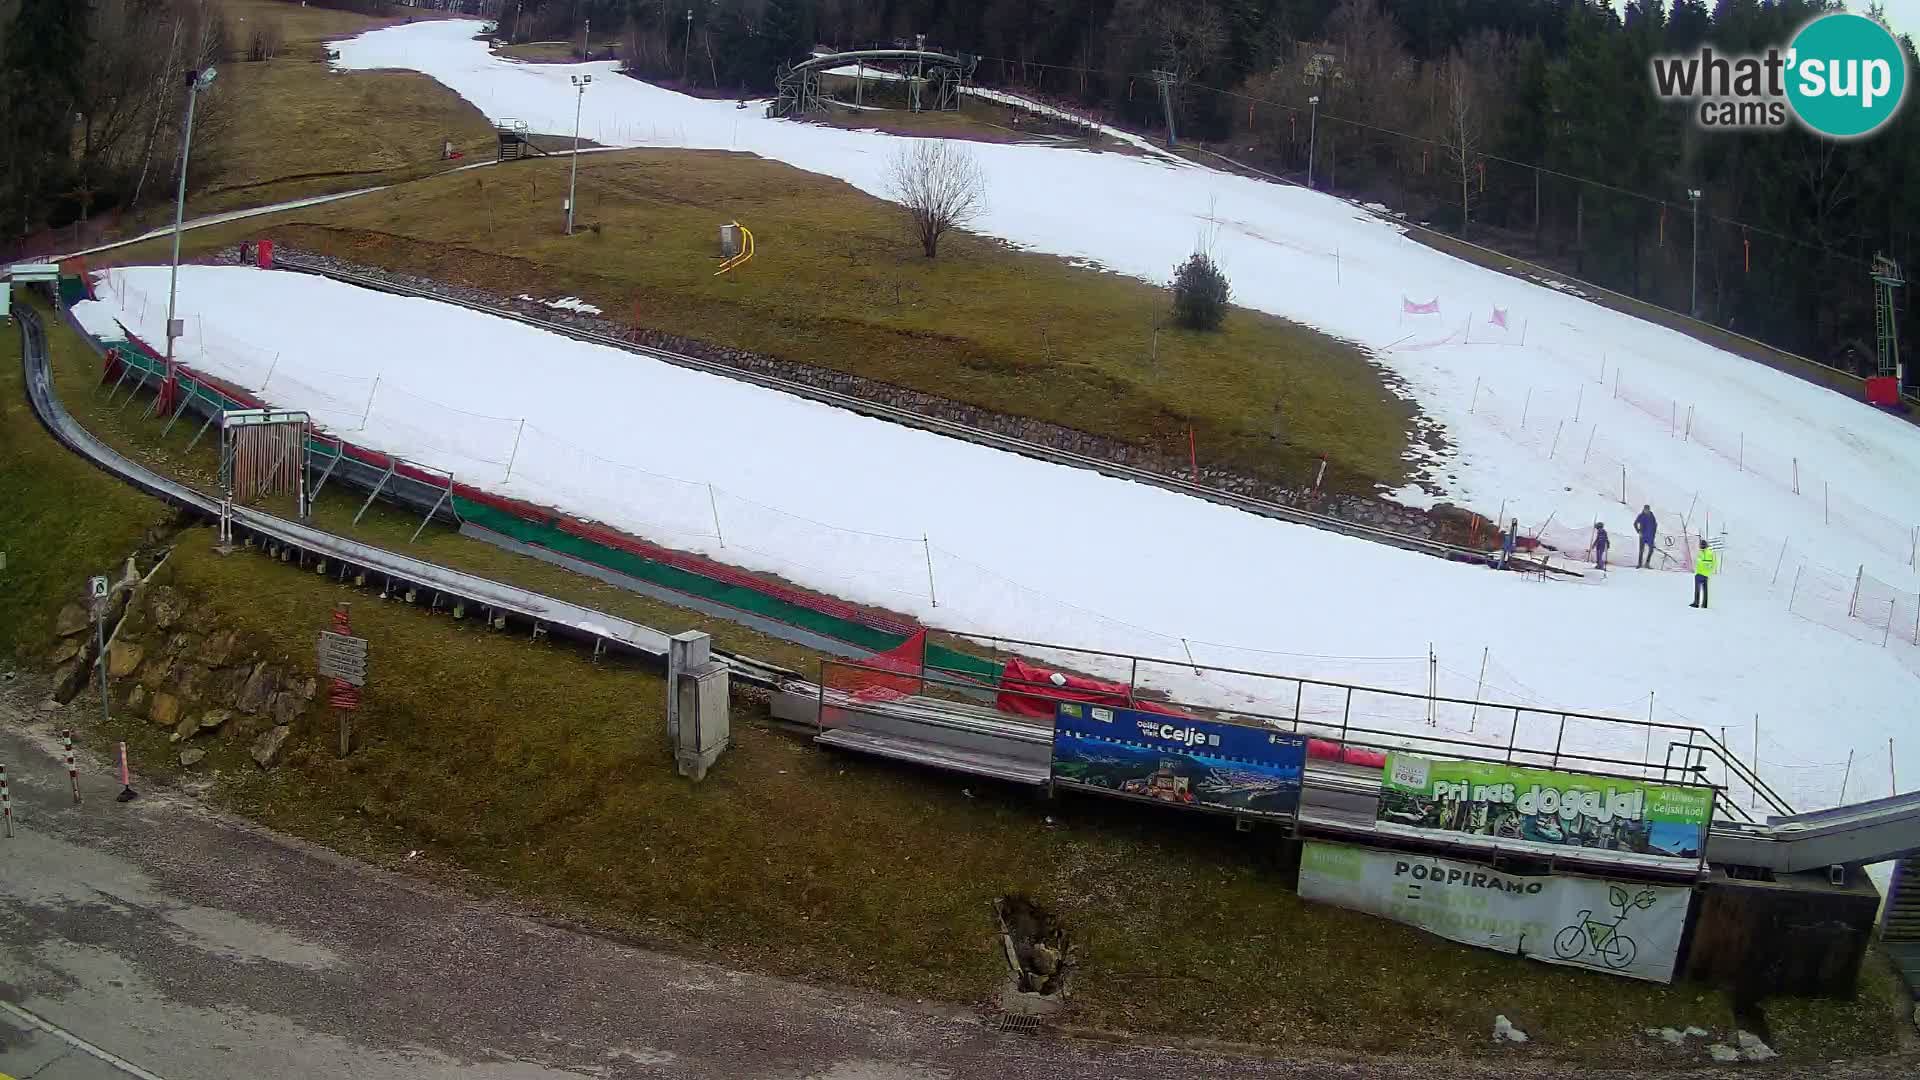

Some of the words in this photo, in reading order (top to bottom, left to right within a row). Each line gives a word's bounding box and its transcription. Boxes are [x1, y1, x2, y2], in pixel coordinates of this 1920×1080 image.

[1160, 724, 1206, 746] Celje
[1432, 779, 1469, 801] Pri
[1473, 783, 1515, 803] nas
[1394, 861, 1543, 894] PODPIRAMO
